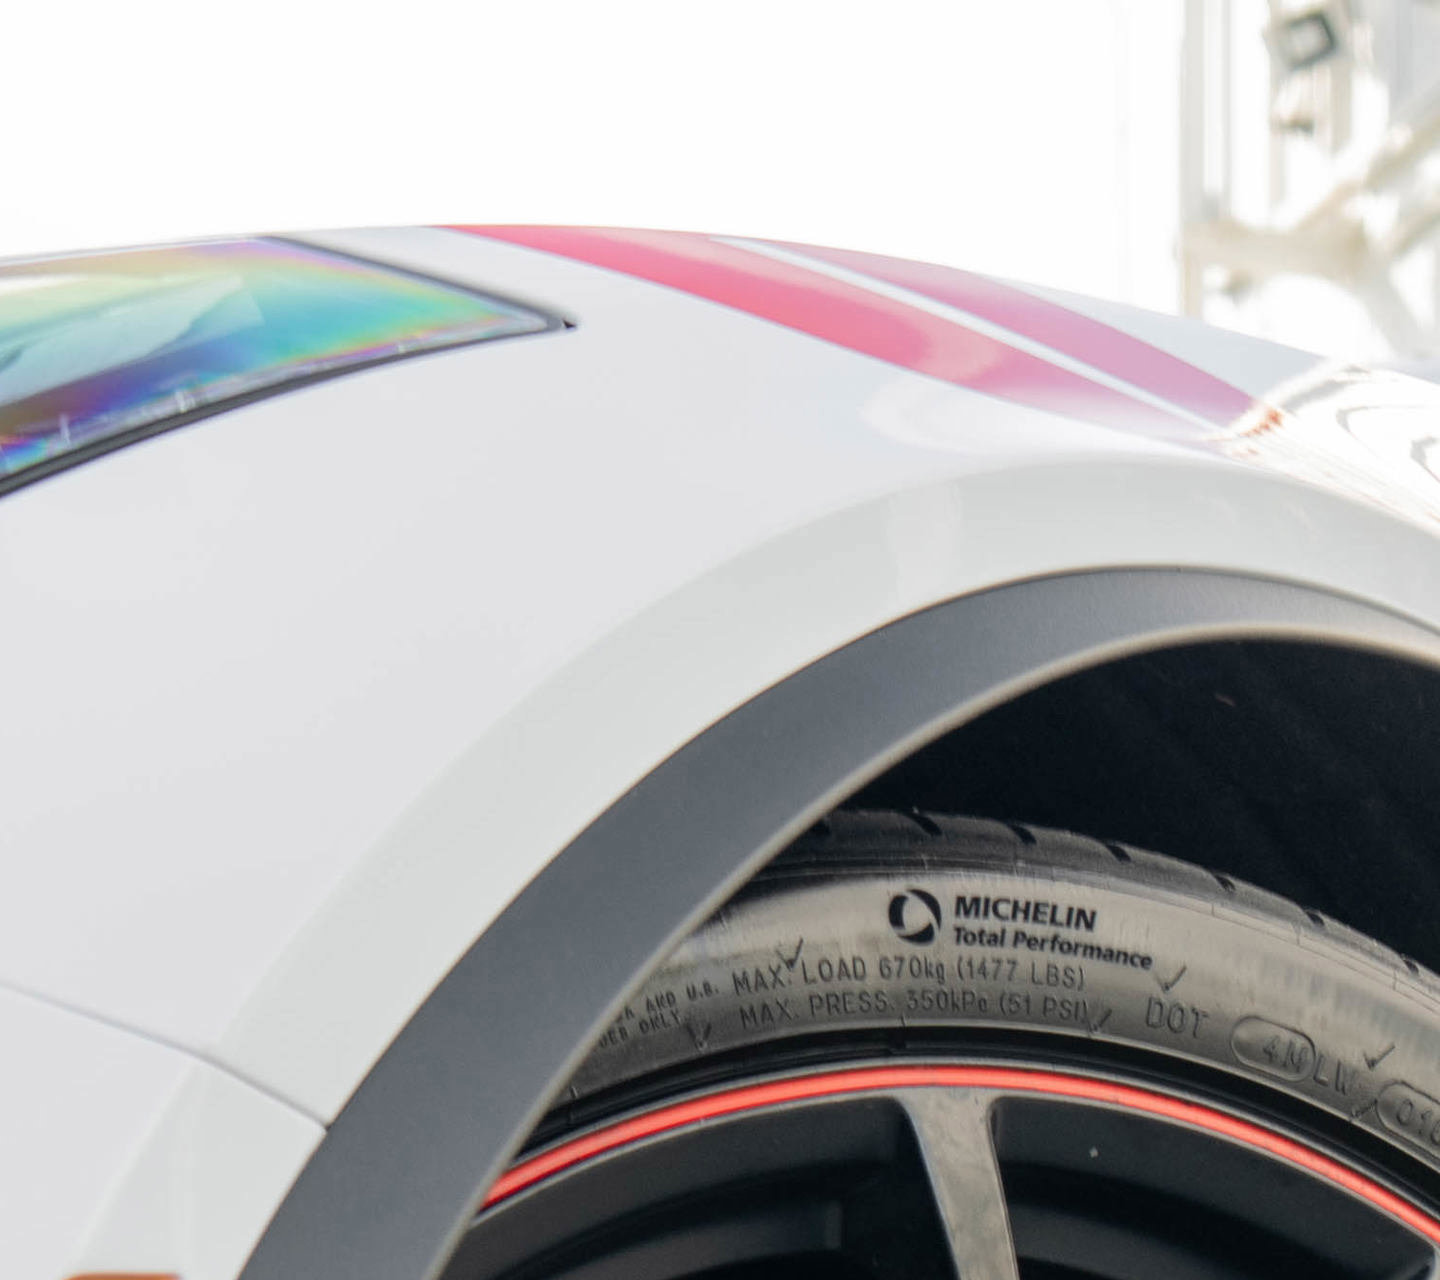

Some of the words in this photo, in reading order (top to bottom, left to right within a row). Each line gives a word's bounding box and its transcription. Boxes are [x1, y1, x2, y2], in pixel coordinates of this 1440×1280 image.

[954, 896, 1098, 933] MICHELIN
[953, 925, 1006, 947] Total
[1011, 931, 1154, 972] Performance
[801, 956, 866, 985] LOAD
[878, 956, 945, 985] 670kg
[955, 956, 1018, 982] (1477
[1029, 960, 1088, 991] LBS)
[809, 989, 895, 1018] PRESS.
[906, 988, 988, 1011] 350kPa
[998, 990, 1033, 1016] (51
[1041, 994, 1090, 1022] PSI)
[1143, 995, 1213, 1040] DOT
